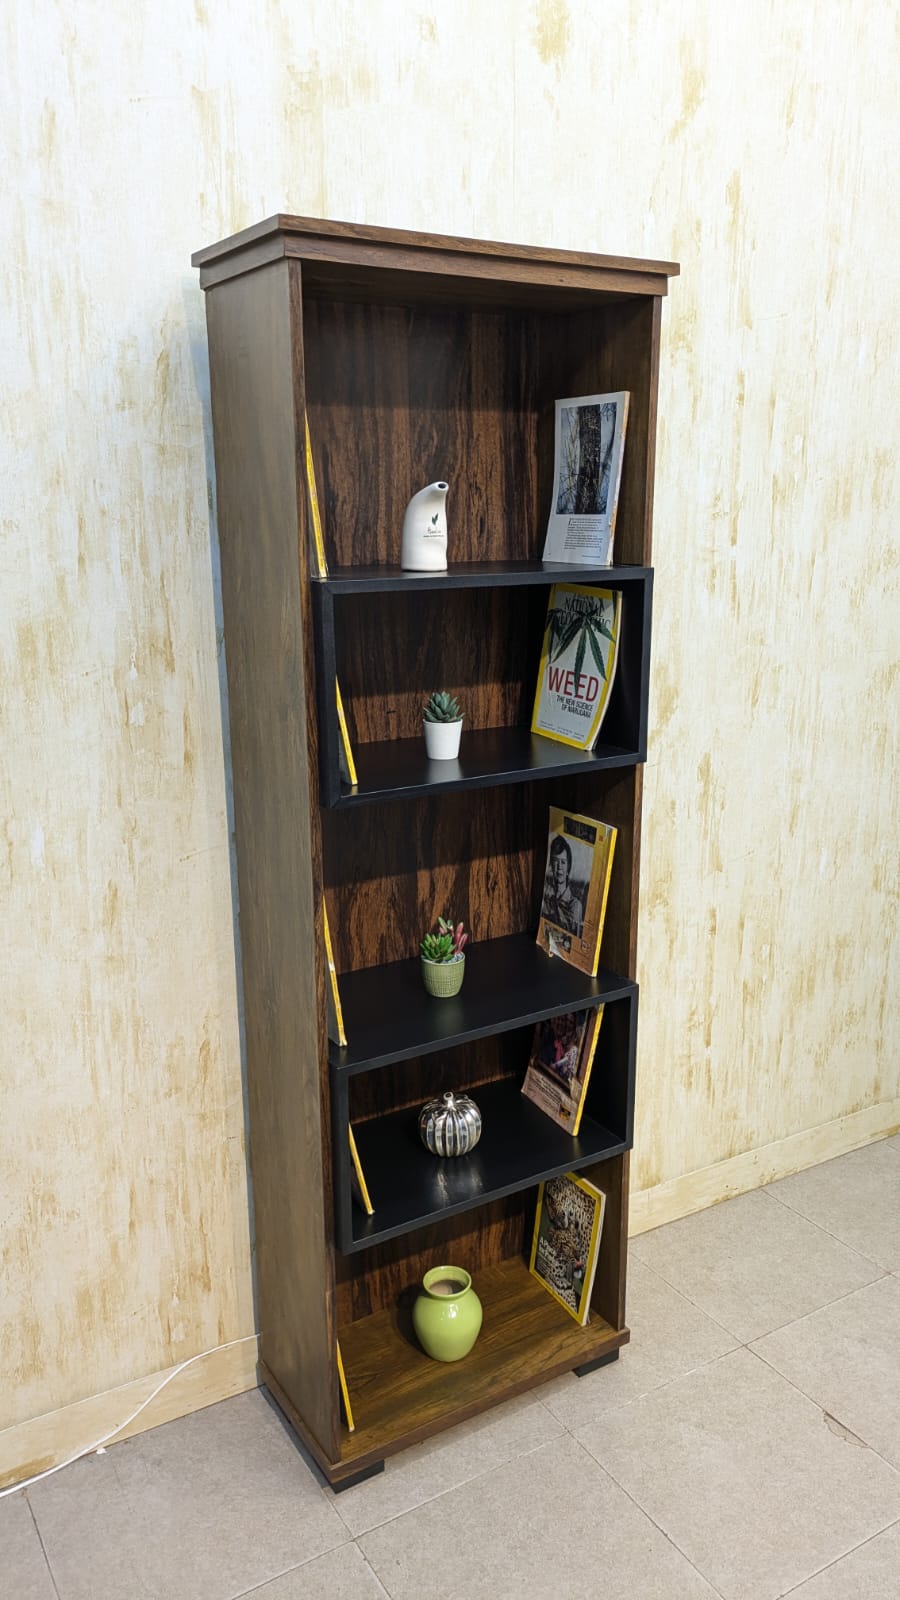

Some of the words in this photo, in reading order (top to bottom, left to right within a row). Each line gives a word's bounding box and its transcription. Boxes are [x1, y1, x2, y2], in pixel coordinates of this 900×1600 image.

[548, 666, 599, 702] WEED
[557, 694, 565, 704] THE
[561, 703, 568, 711] OF
